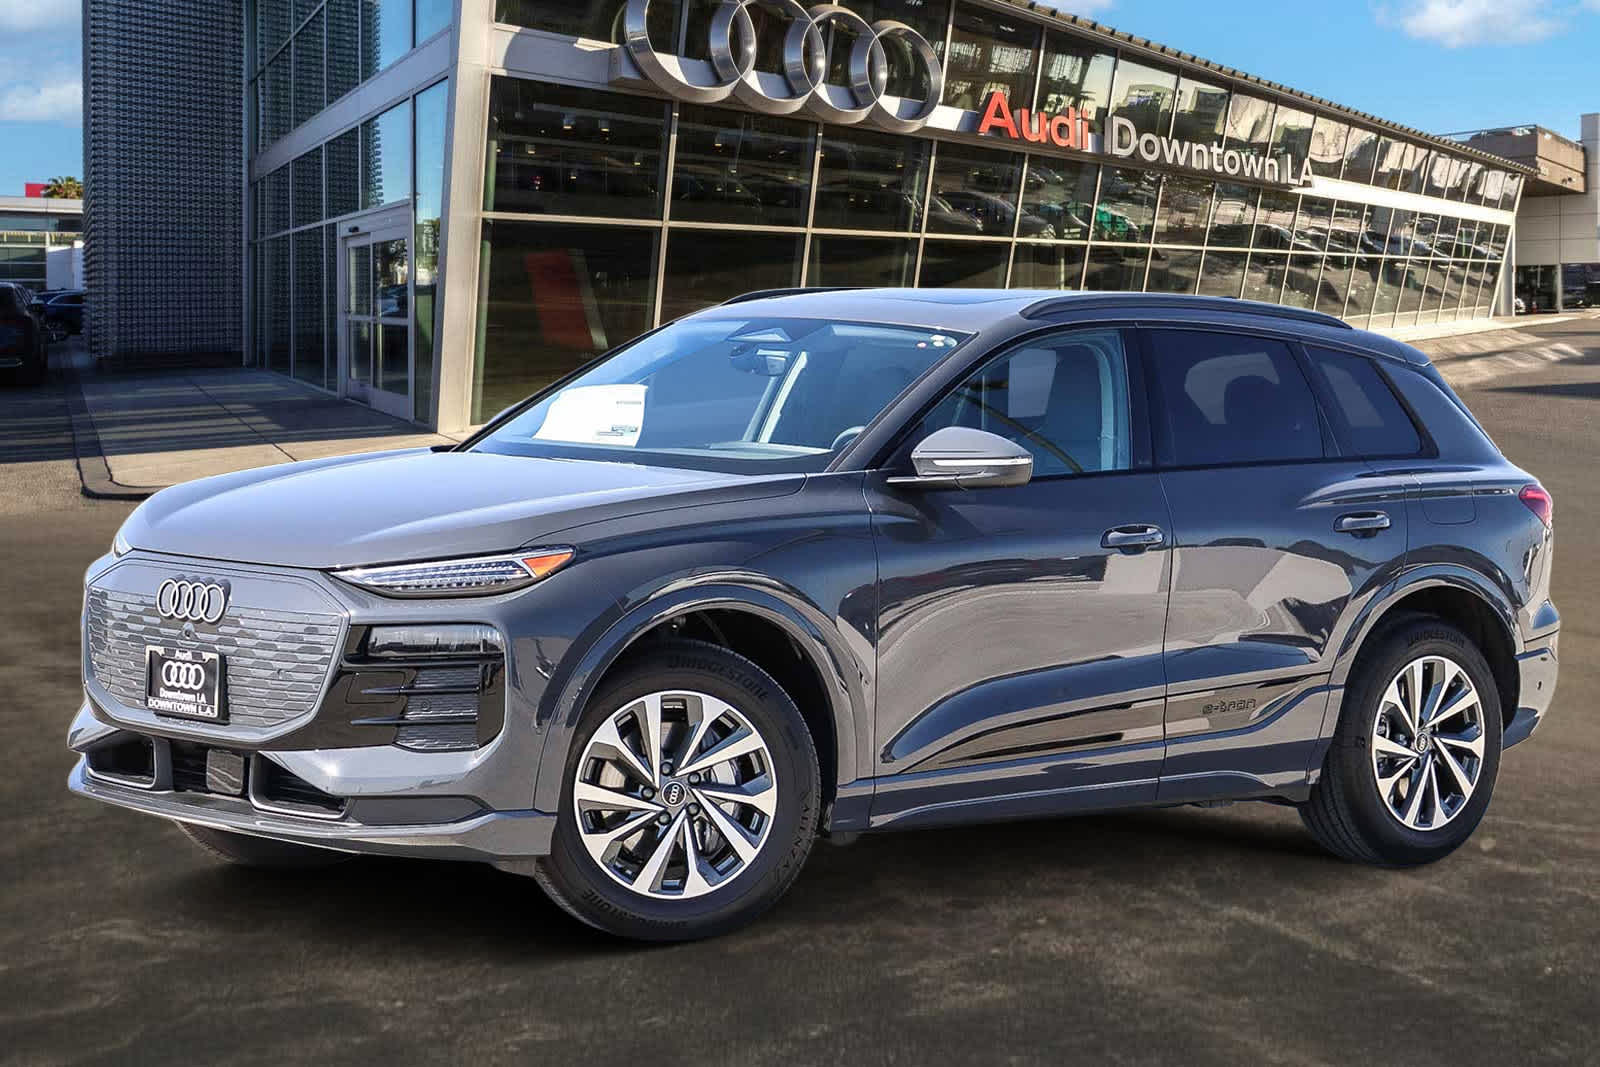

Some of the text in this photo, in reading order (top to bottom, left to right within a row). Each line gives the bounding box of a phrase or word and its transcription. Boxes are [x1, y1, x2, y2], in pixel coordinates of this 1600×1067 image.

[978, 91, 1317, 189] Audi Downtown LA
[147, 698, 197, 714] DOWNTOWN
[1201, 698, 1257, 715] e-tron
